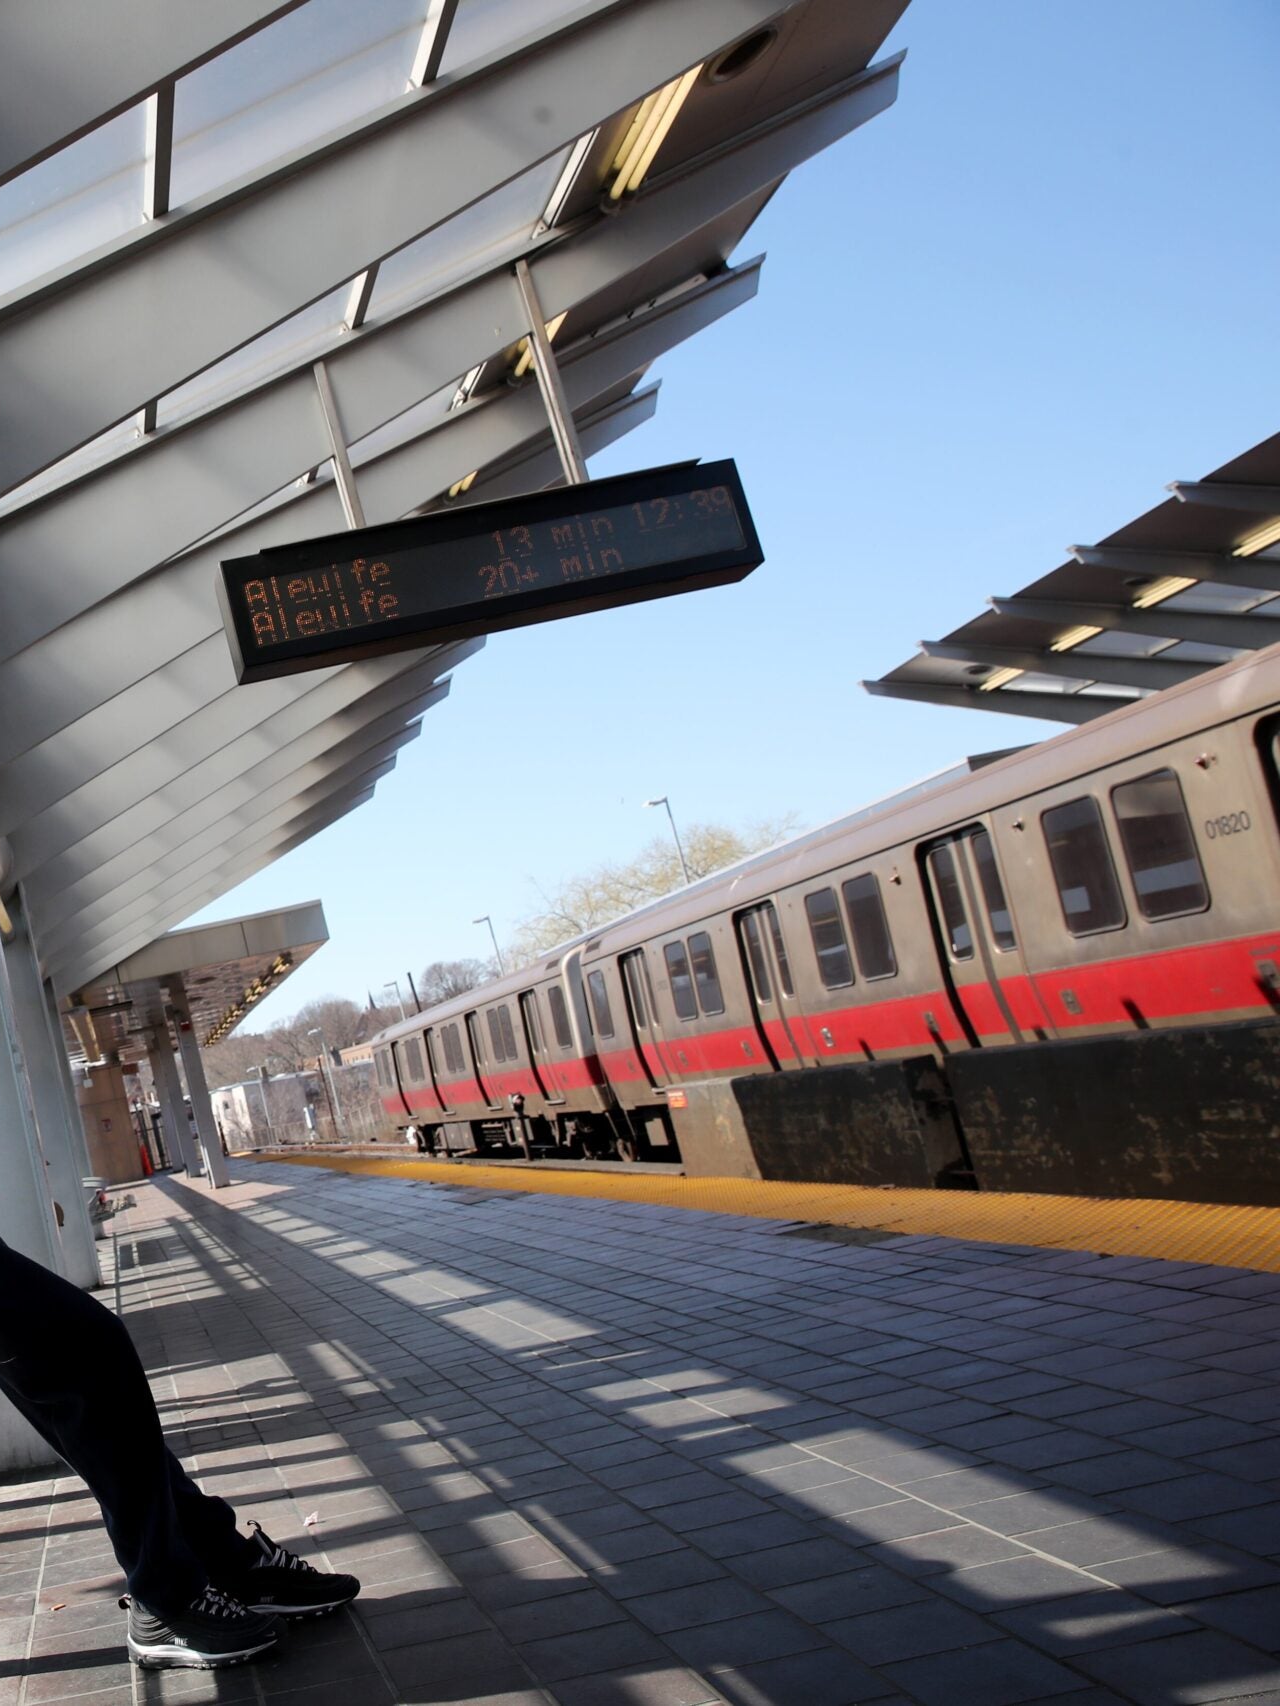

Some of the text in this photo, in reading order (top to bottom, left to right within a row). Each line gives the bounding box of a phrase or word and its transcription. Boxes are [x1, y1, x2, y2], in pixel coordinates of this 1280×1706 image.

[243, 558, 392, 613] Alewife
[491, 524, 533, 561] 13
[550, 513, 615, 550] min
[559, 544, 625, 582] min
[1204, 810, 1252, 840] 01820
[174, 1636, 189, 1647] NIKE
